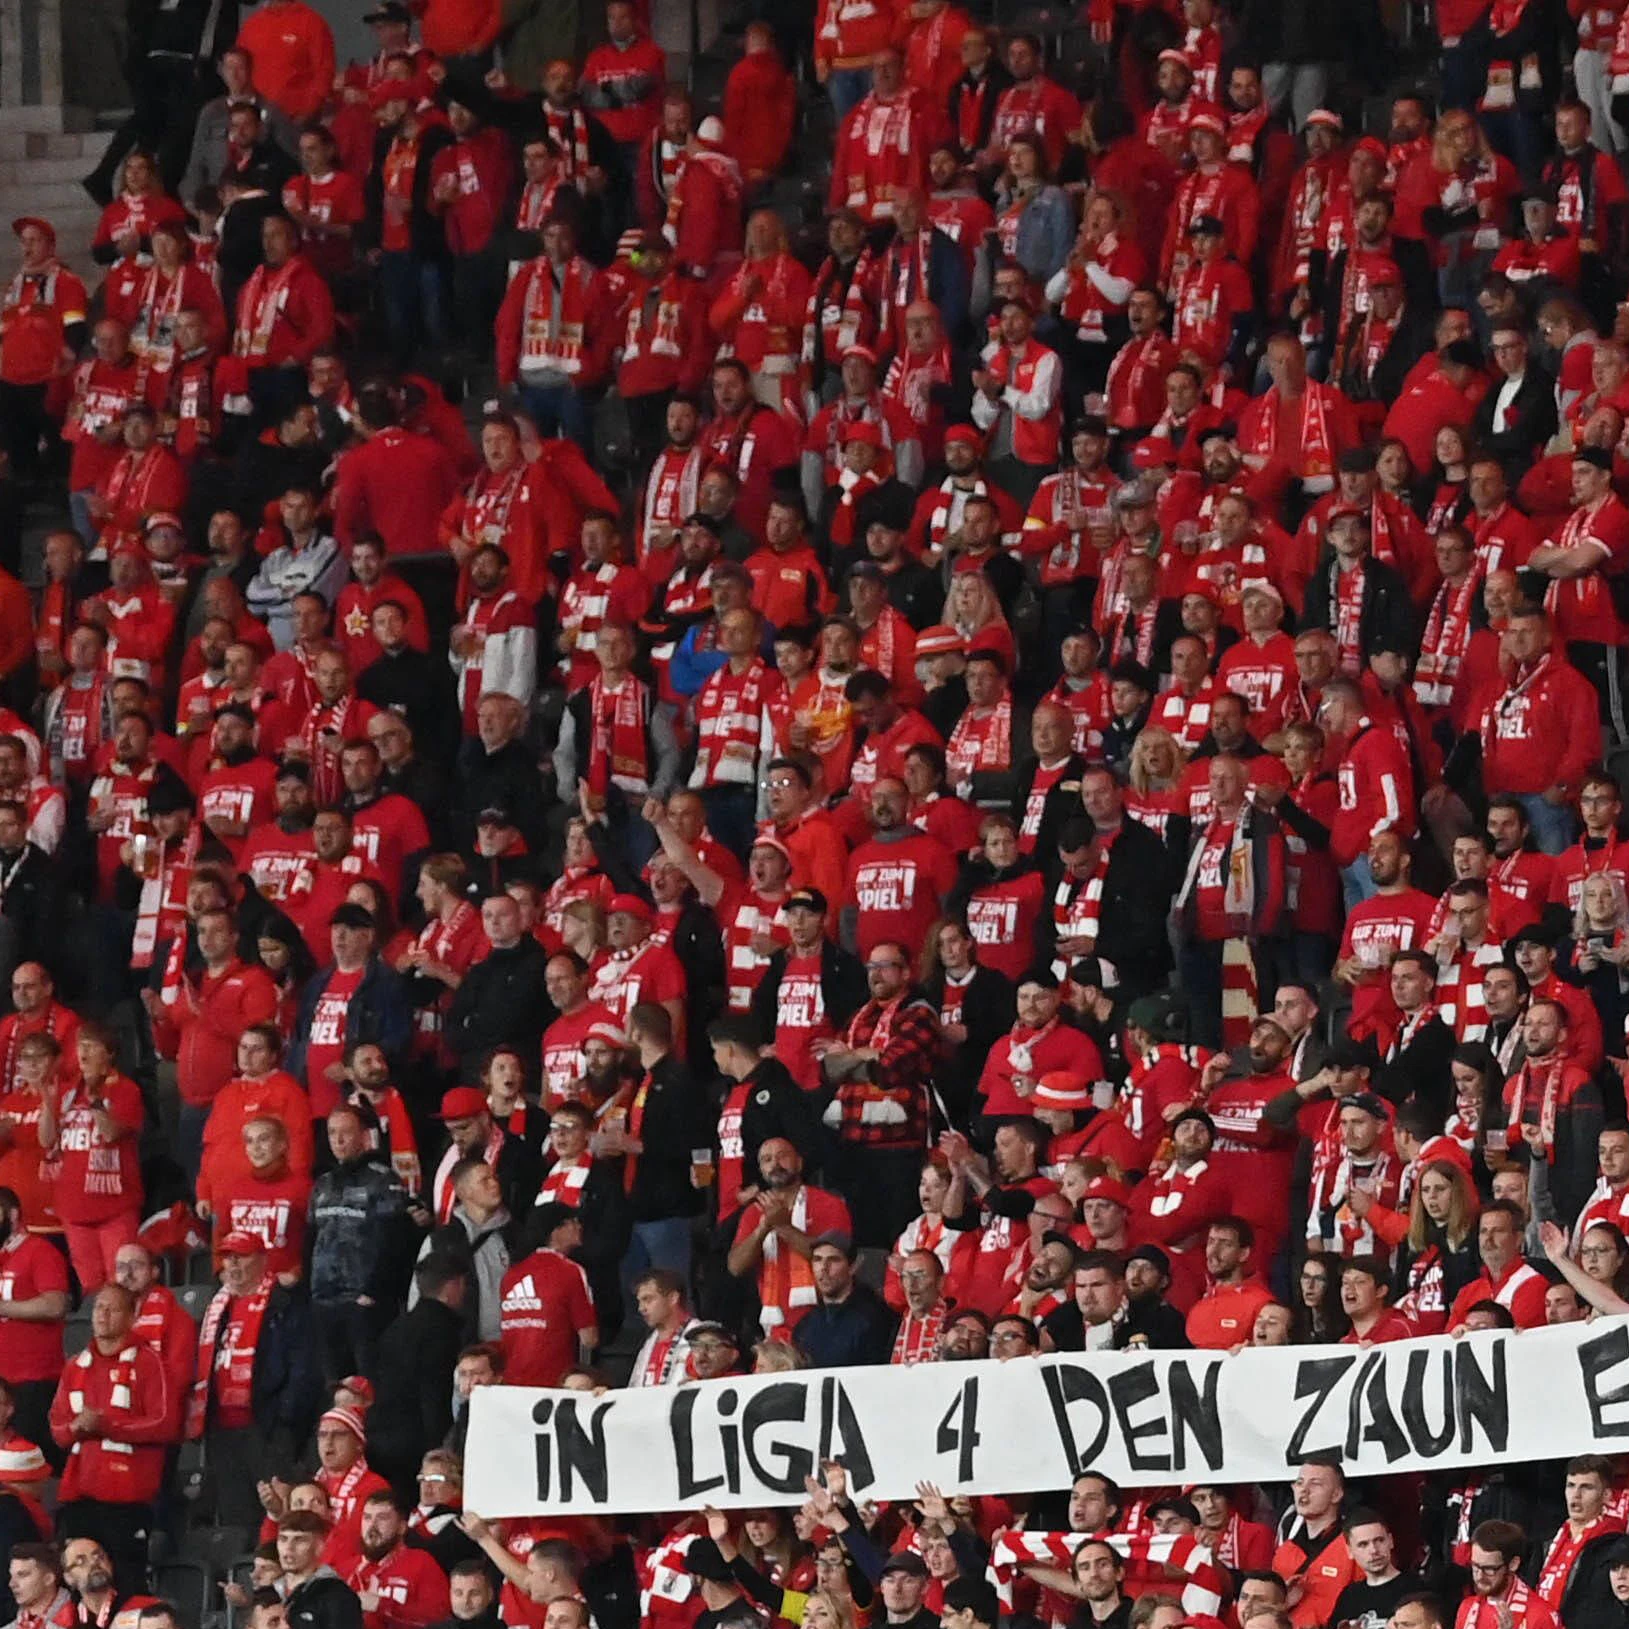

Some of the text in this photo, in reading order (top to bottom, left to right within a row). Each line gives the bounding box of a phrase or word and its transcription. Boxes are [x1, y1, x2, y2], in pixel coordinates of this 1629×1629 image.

[877, 867, 902, 882] ZUM
[936, 1376, 981, 1483] 4
[1041, 1360, 1223, 1477] DEN
[1286, 1339, 1508, 1467] ZAUN
